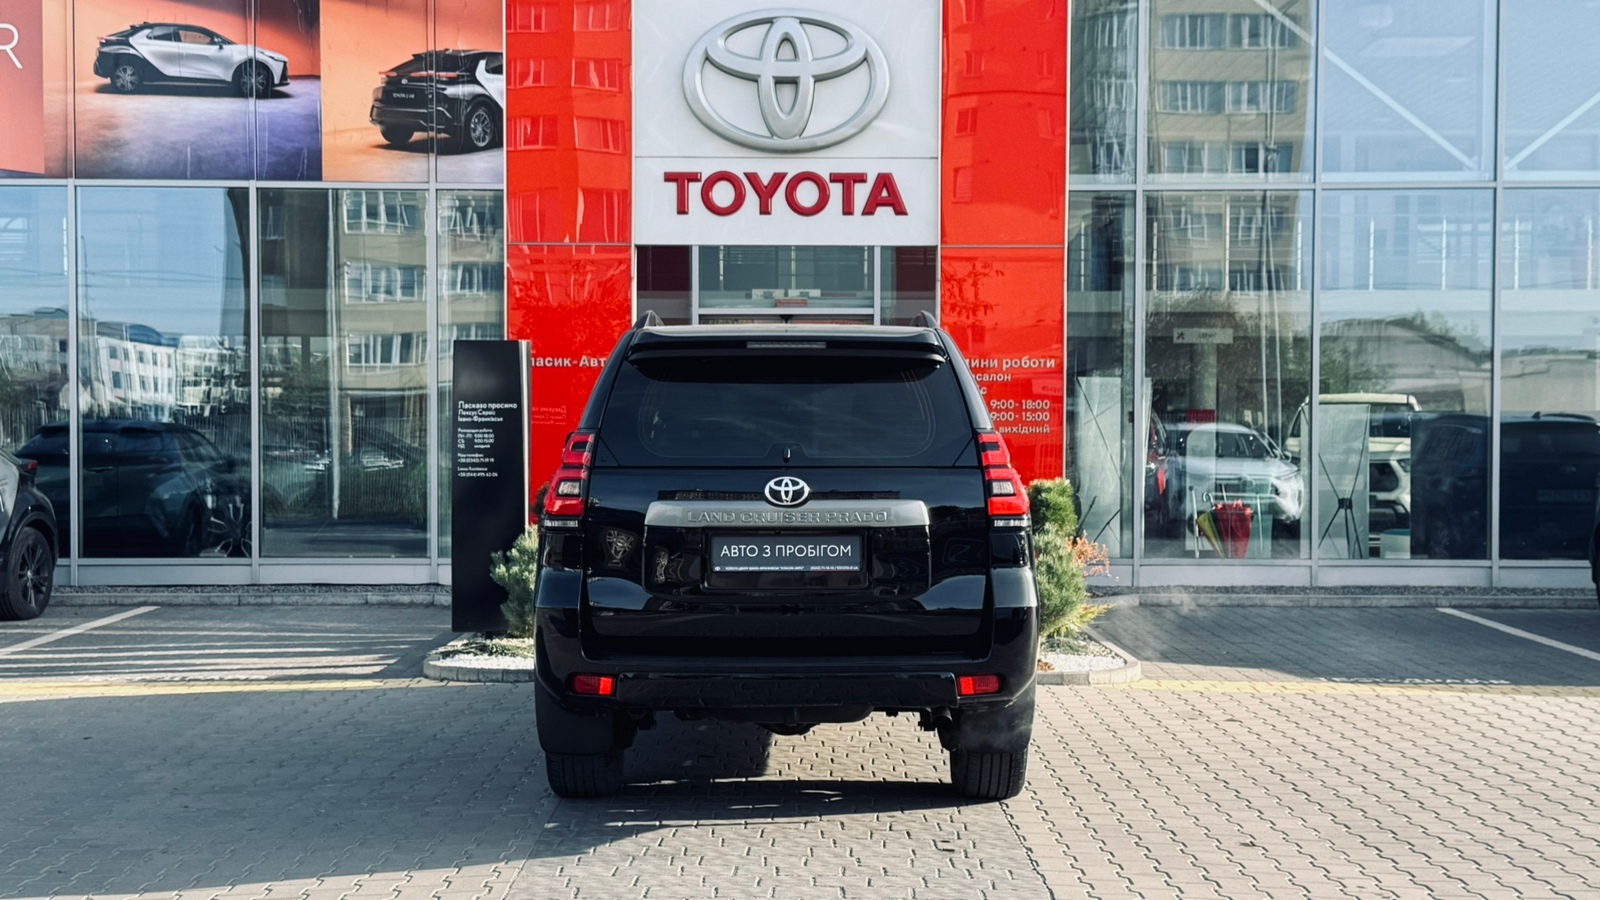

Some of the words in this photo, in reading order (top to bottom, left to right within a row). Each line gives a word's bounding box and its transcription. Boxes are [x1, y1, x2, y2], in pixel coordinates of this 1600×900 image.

[664, 171, 908, 216] TOYOTA
[1003, 356, 1055, 371] роботи
[973, 373, 1011, 382] салон
[458, 401, 487, 409] Ласкаво
[999, 424, 1050, 434] вихідний
[687, 511, 736, 523] LAND
[740, 511, 821, 523] CRUISER
[825, 511, 888, 523] PRADO
[720, 545, 759, 557] АВТО
[762, 545, 771, 557] З
[775, 545, 852, 557] ПРОБІГОМ
